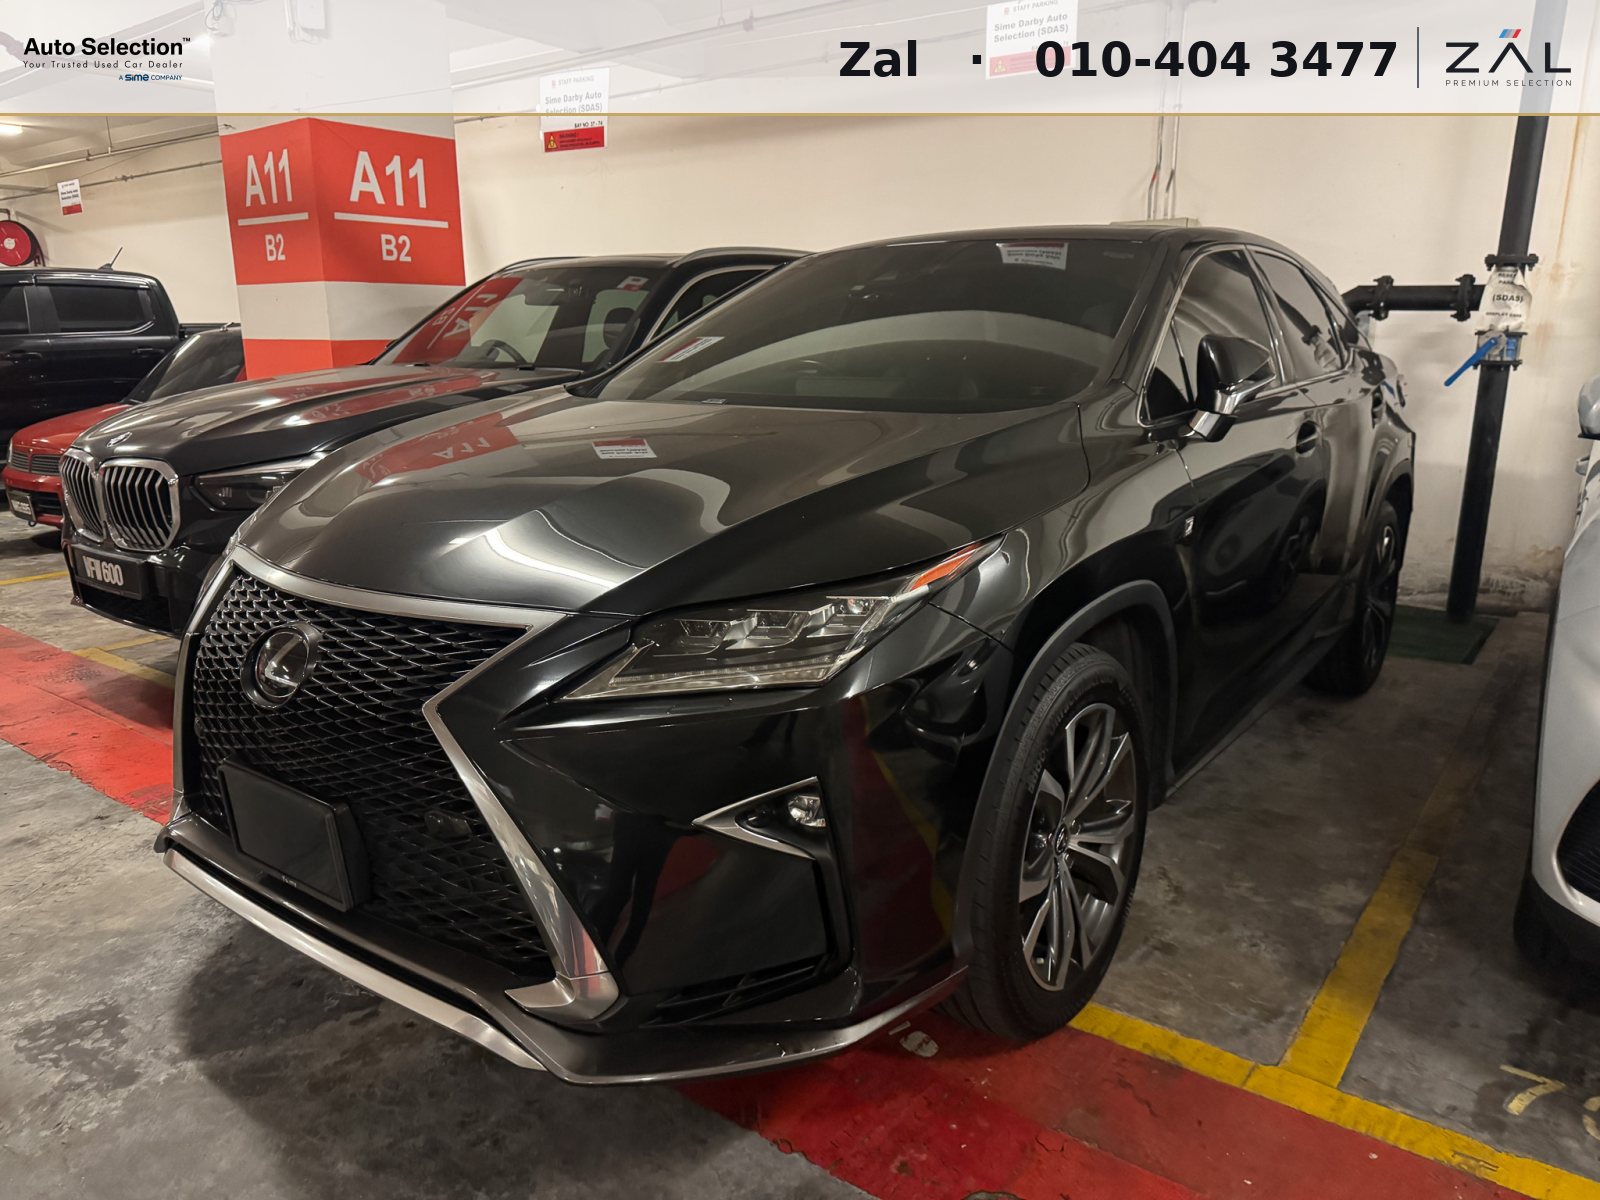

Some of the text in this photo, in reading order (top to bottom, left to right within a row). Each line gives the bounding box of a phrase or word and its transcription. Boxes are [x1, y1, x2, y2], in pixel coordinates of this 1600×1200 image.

[994, 14, 1068, 32] Sime Darby Auto
[994, 31, 1035, 43] Selection
[545, 91, 602, 104] Sime Darby Auto
[246, 148, 293, 207] A11
[350, 151, 427, 208] A11
[265, 233, 286, 262] B2
[380, 233, 412, 262] B2
[1492, 294, 1524, 303] (SDAS)
